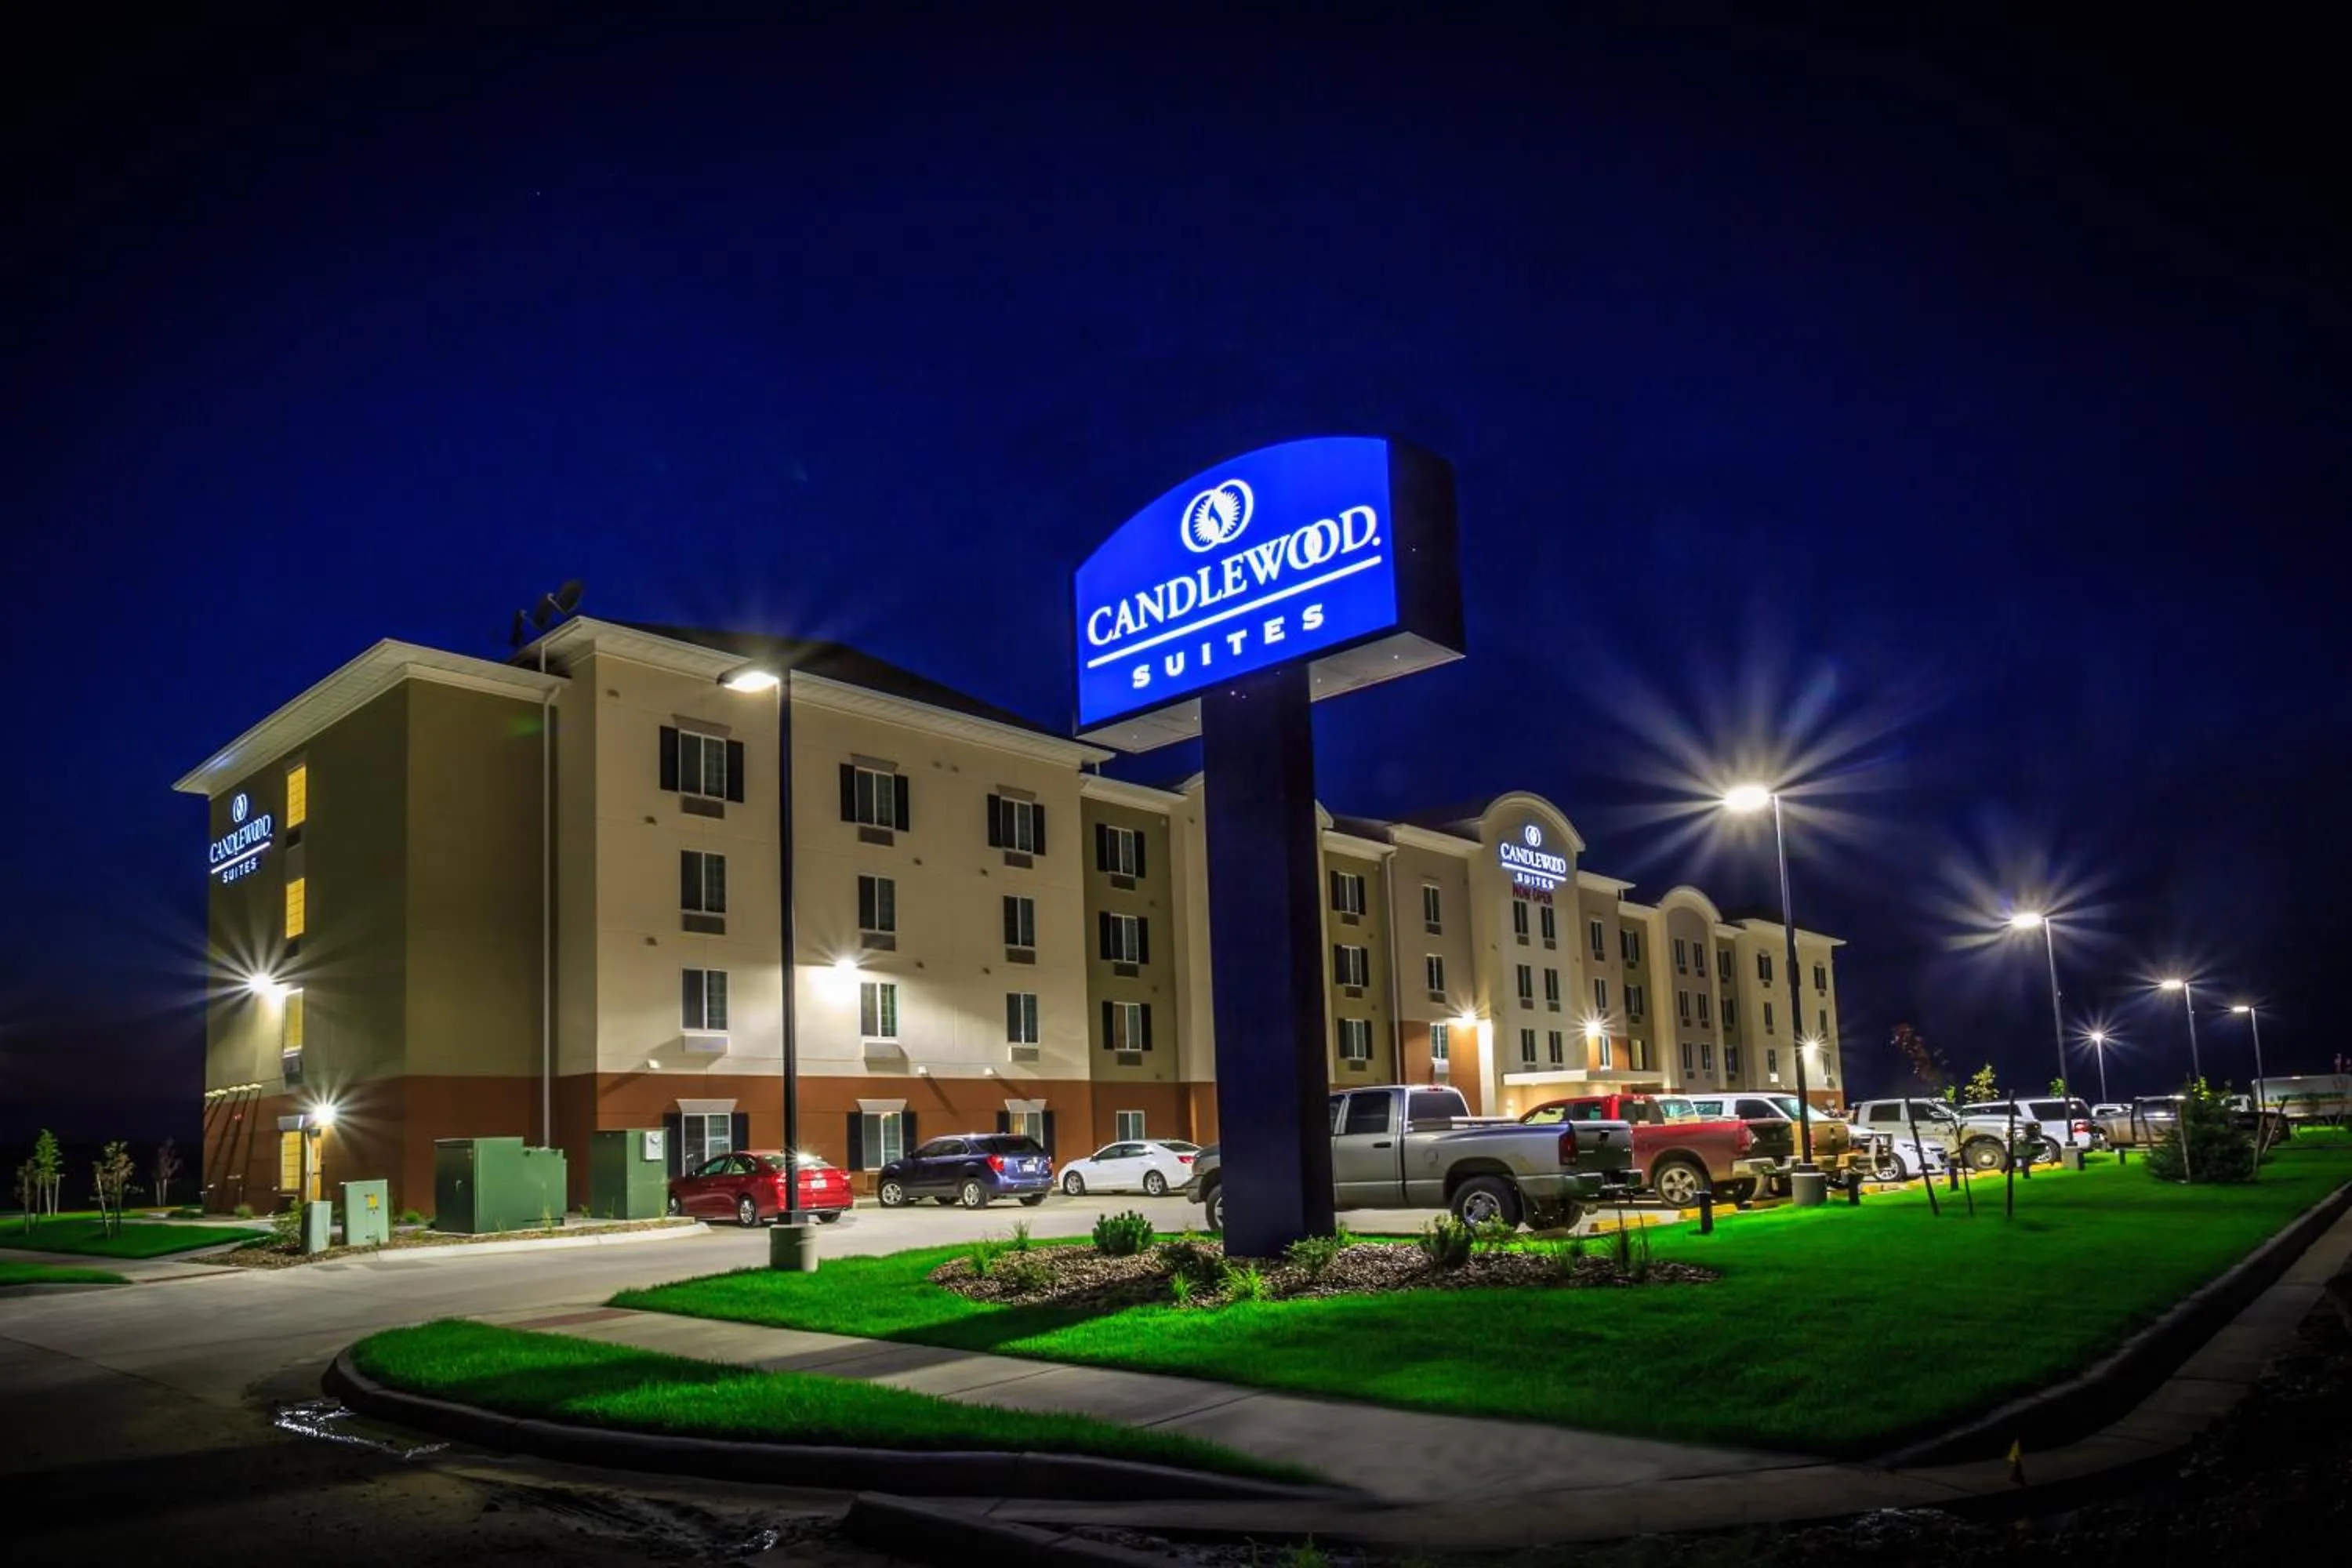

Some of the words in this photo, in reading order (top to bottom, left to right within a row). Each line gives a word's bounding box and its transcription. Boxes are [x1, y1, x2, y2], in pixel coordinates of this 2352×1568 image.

[1131, 603, 1325, 689] SUITES
[223, 857, 257, 884] SUITES
[1515, 872, 1554, 890] SUITES
